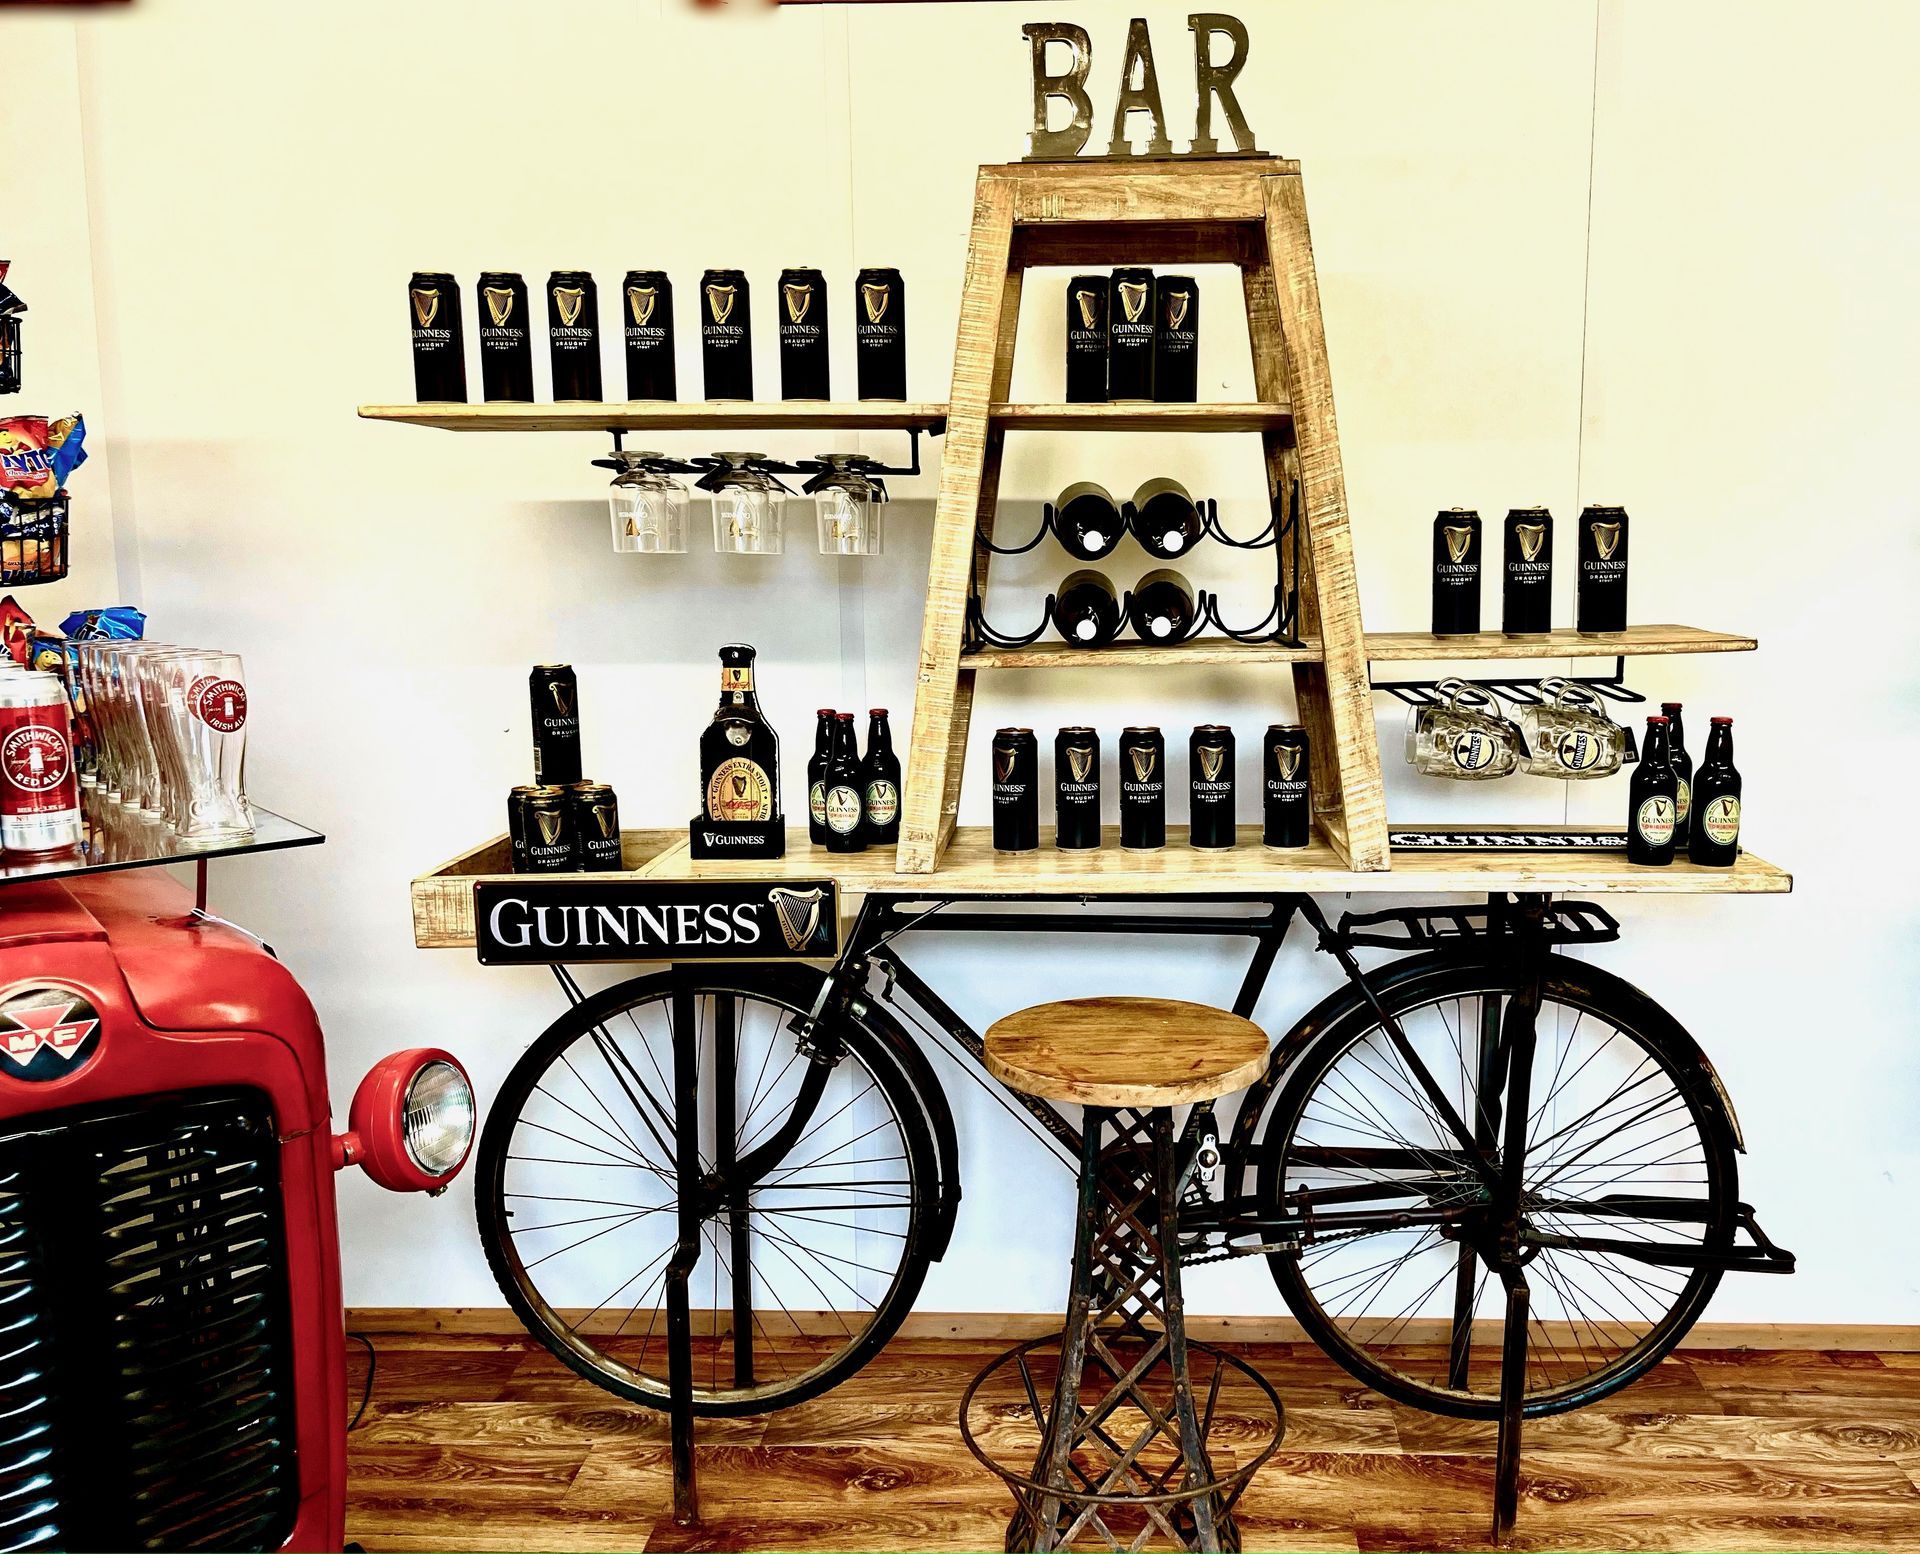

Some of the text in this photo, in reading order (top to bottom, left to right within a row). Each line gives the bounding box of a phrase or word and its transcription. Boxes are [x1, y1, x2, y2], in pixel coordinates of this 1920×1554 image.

[1022, 13, 1255, 156] BAR
[481, 327, 523, 337] GUINNESS
[551, 327, 592, 337] GUINNESS
[625, 327, 665, 337] GUINNESS
[703, 325, 743, 335] GUINNESS
[780, 325, 819, 335] GUINNESS
[858, 325, 897, 334] GUINNESS
[1112, 324, 1154, 334] GUINNESS
[1070, 330, 1106, 340] GUINNES
[1158, 331, 1195, 341] UINNESS
[1437, 564, 1477, 573] GUINNESS
[1508, 562, 1550, 572] GUINNESS
[1584, 560, 1625, 571] GUINNESS
[209, 714, 244, 730] IRISH ALE
[1466, 732, 1482, 769] GUINNESS
[1570, 732, 1588, 769] GUINNESS
[15, 768, 61, 787] RED ALE
[713, 761, 769, 793] GUINNESS EXTRA STOUT
[992, 784, 1025, 793] UINNESS
[1060, 782, 1099, 792] GUINNESS
[1124, 782, 1162, 791] GUINNESS
[1192, 780, 1231, 791] GUINNESS
[1268, 780, 1307, 790] GUINNESS
[866, 798, 896, 806] GUINNESS
[828, 805, 858, 813] GUINNESS
[1641, 816, 1674, 824] GUINNESS
[715, 834, 765, 845] GUINNESS
[530, 844, 571, 856] GUINNESS
[489, 898, 761, 947] GUINNESS
